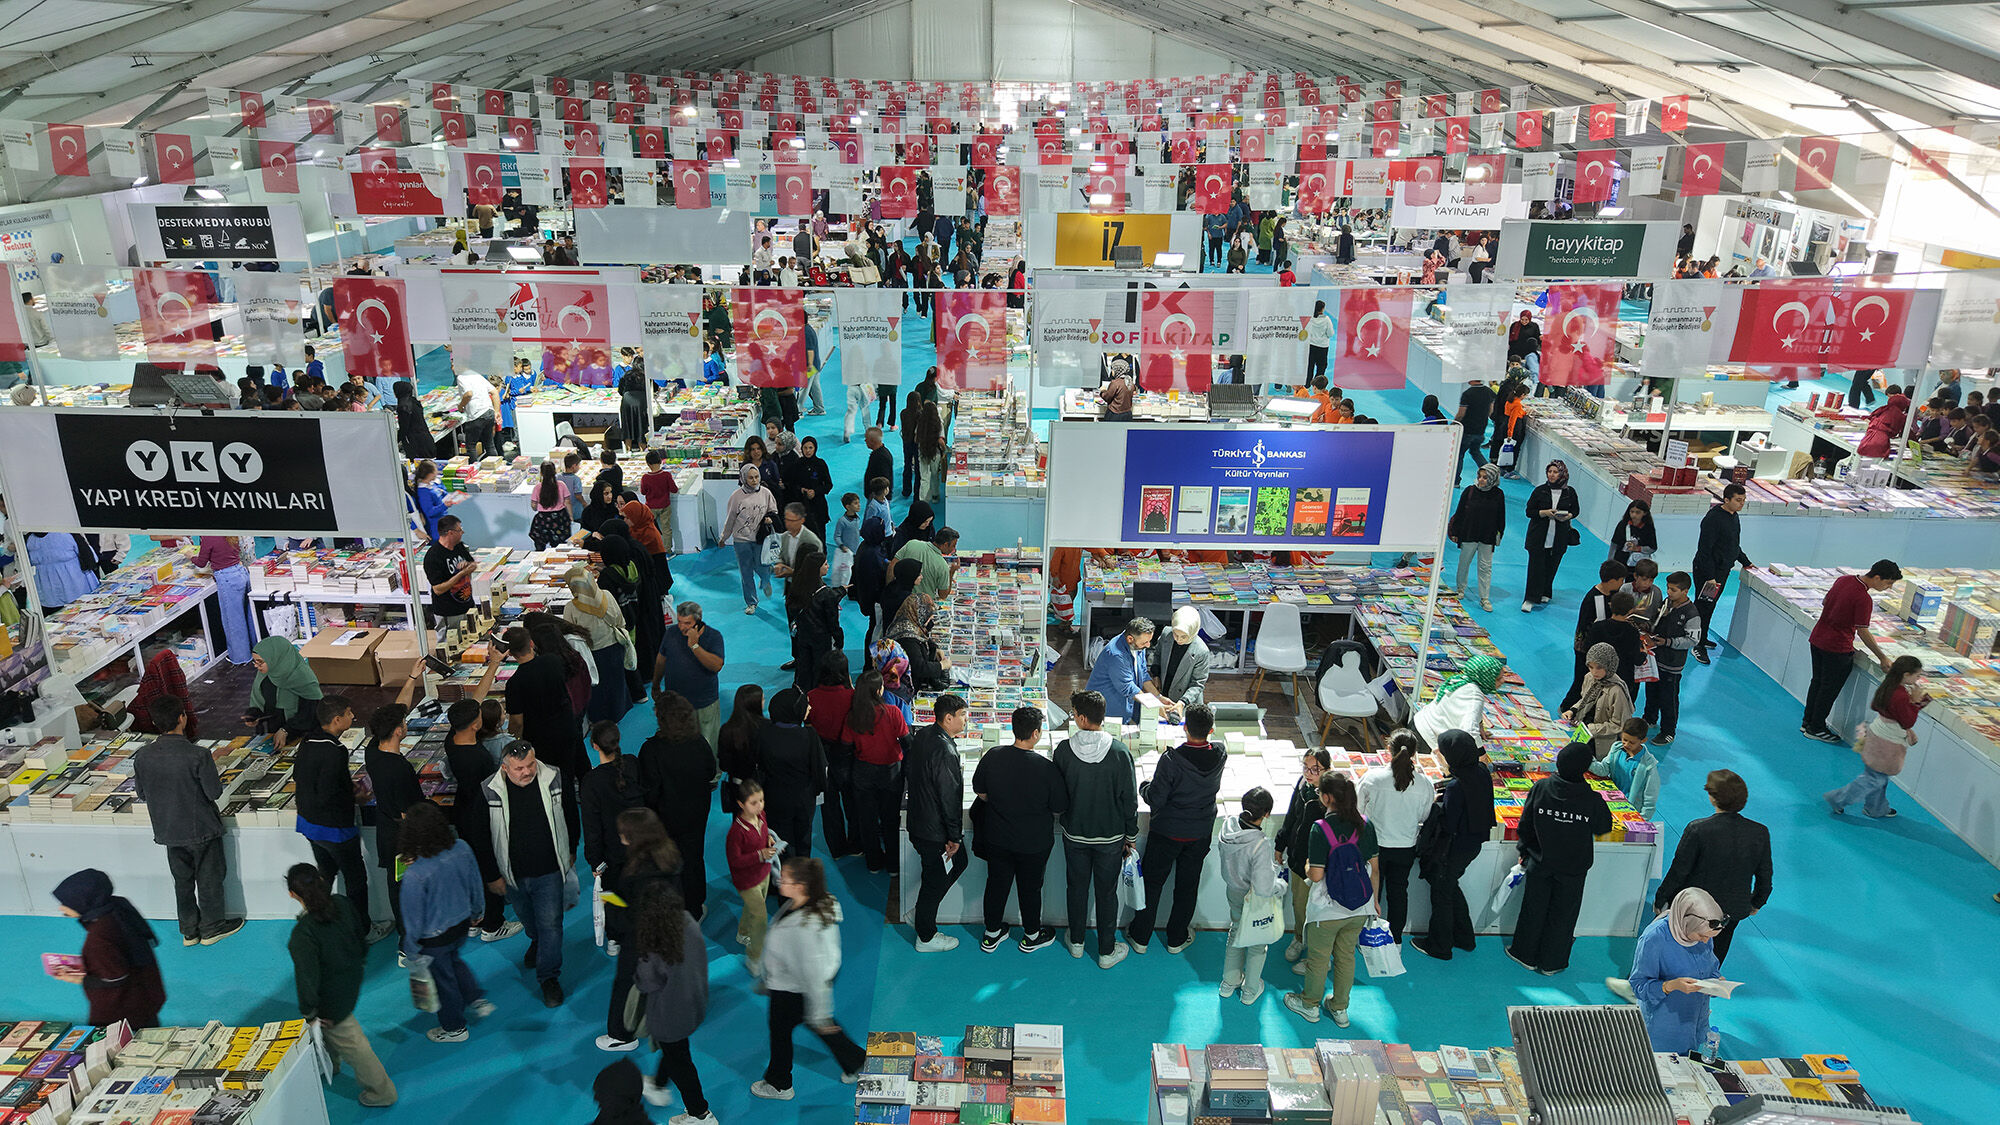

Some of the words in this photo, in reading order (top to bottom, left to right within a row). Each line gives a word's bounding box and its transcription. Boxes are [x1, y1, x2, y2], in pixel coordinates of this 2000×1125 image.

[1451, 195, 1474, 204] NAR
[1434, 207, 1489, 217] YAYINLARI
[234, 219, 270, 228] GRUBU
[1545, 234, 1624, 255] hayykitap
[1212, 449, 1251, 458] TÜRKİYE
[1267, 450, 1307, 460] BANKASI
[134, 450, 252, 473] YKY
[1225, 470, 1251, 478] Kültür
[1253, 471, 1289, 480] Yayınları
[80, 488, 130, 507] YAPI
[135, 487, 204, 508] KREDİ
[207, 491, 326, 510] YAYINLARI
[1538, 808, 1589, 823] DESTINY
